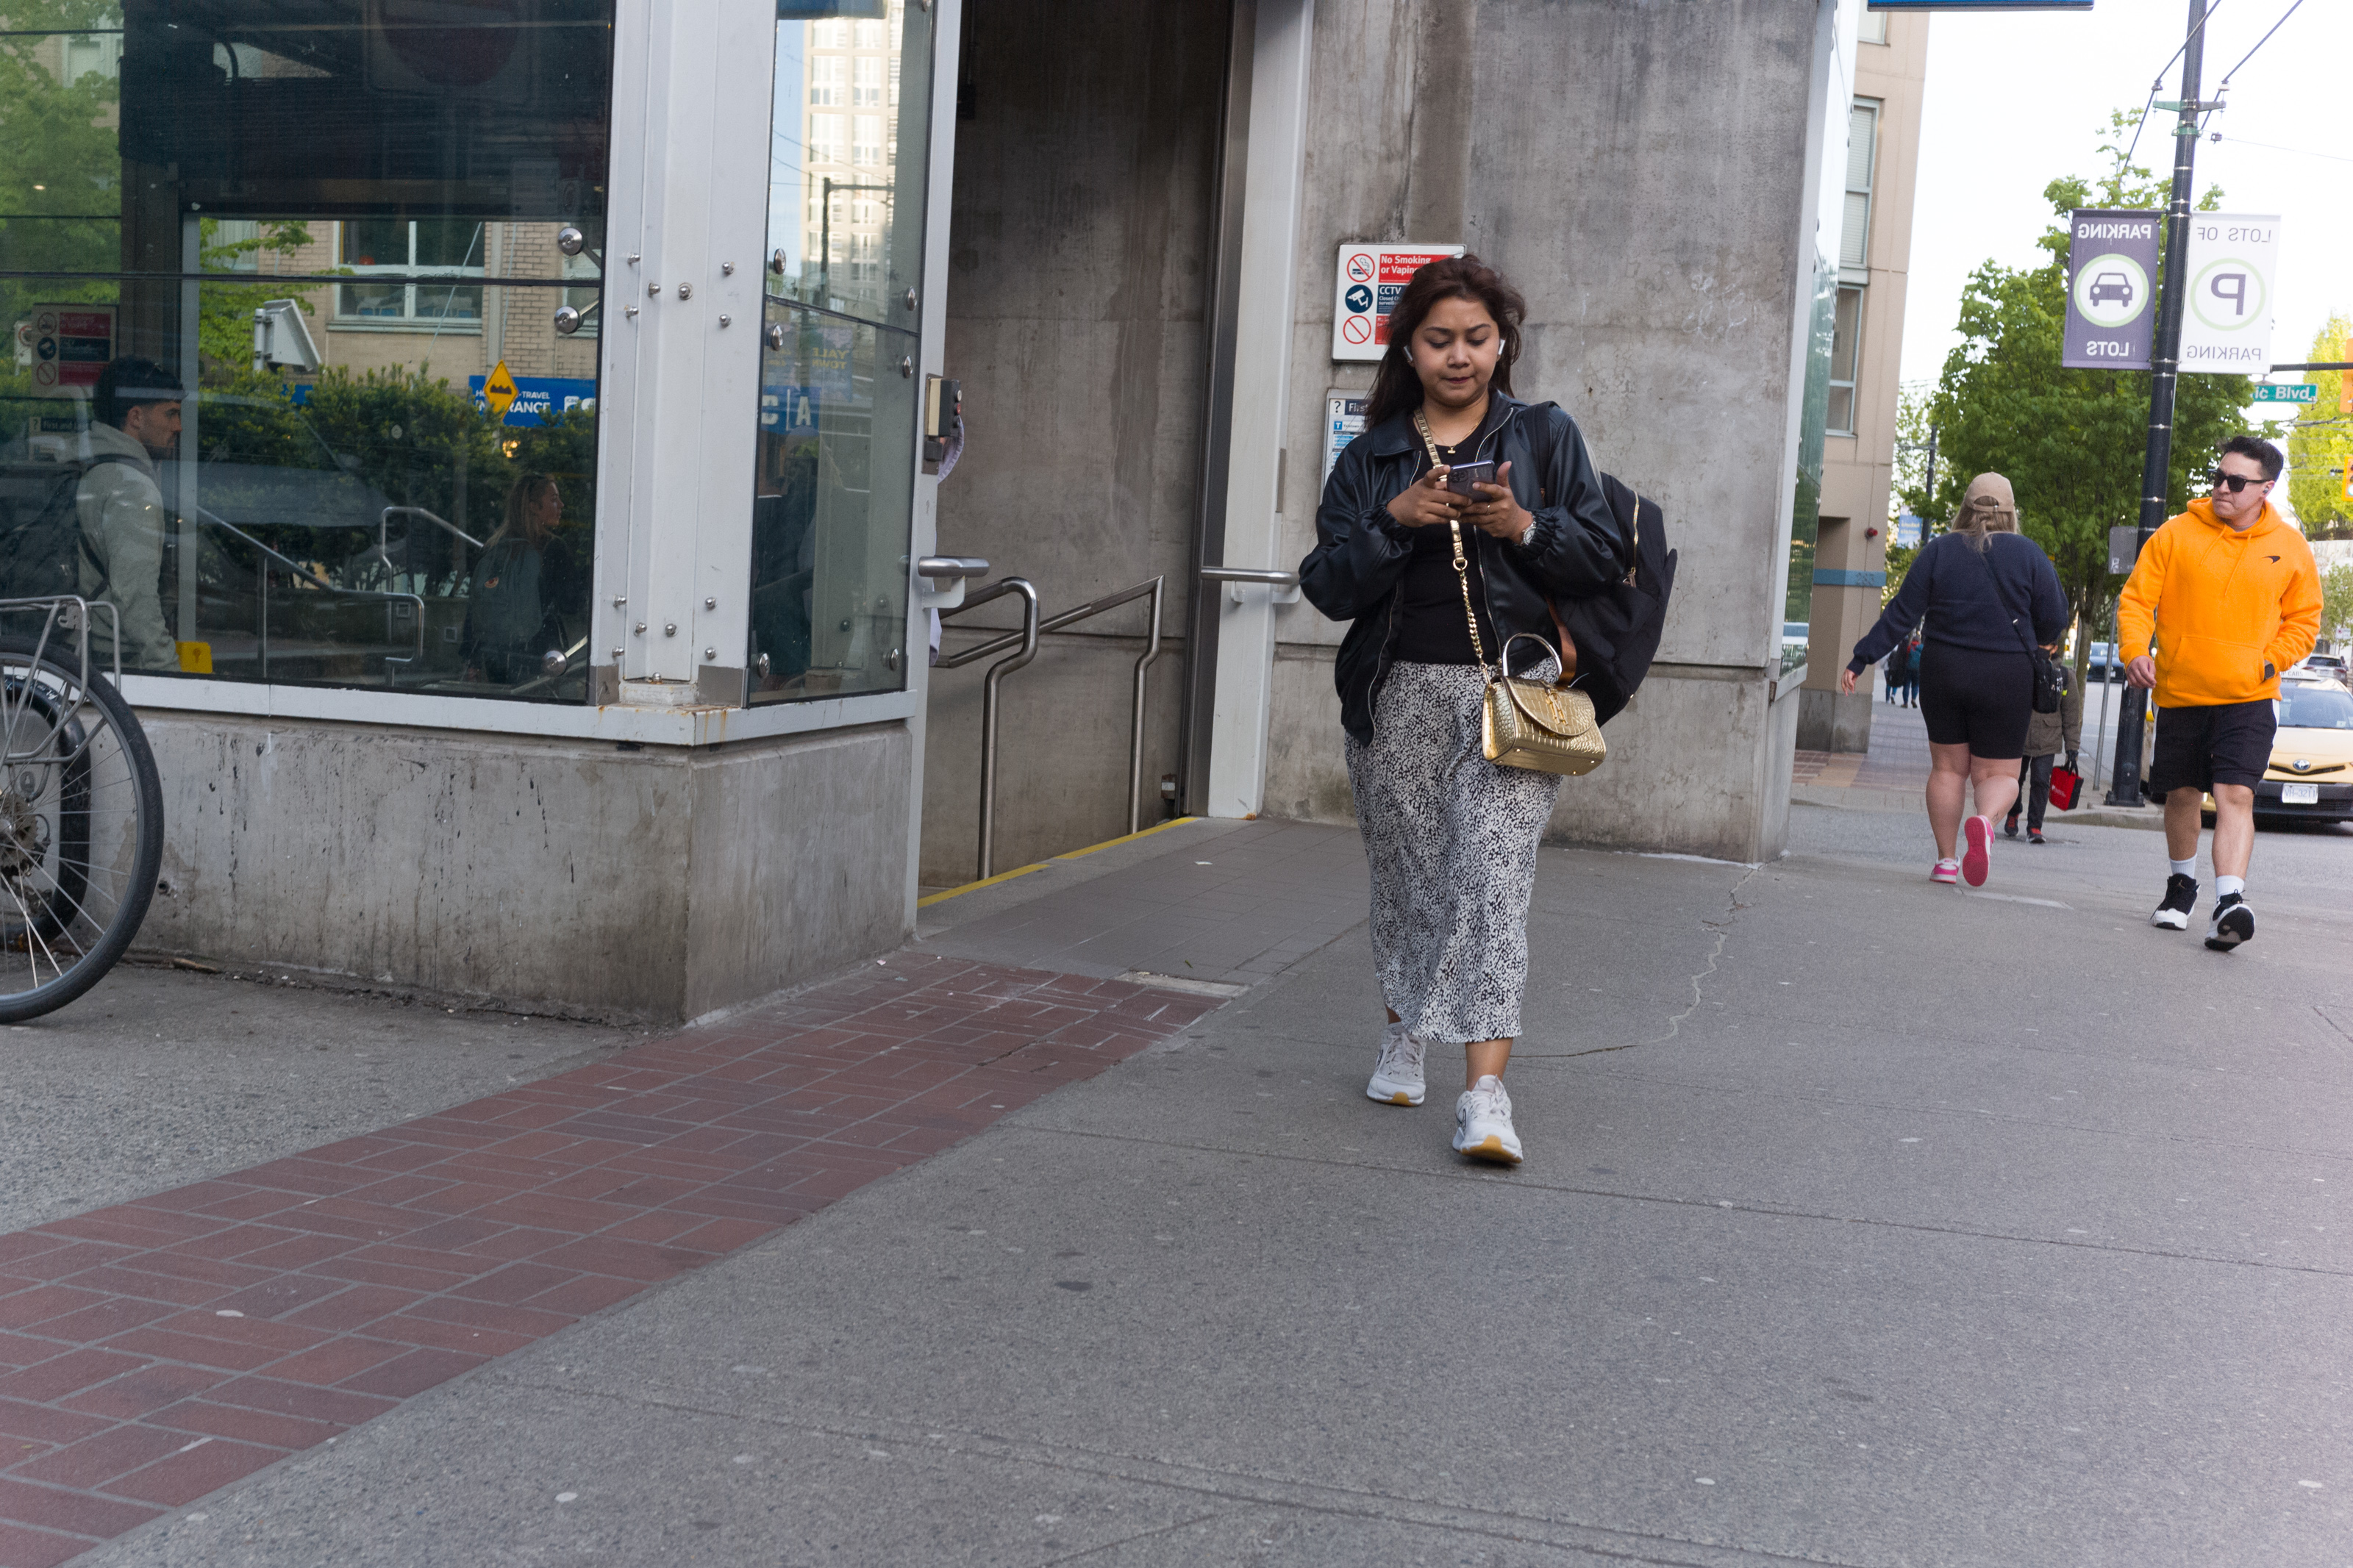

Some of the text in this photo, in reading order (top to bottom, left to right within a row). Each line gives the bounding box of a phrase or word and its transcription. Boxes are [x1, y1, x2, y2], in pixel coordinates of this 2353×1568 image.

[1381, 255, 1393, 264] No
[1391, 265, 1418, 276] Vapin
[1379, 286, 1402, 295] CCTV
[2276, 386, 2310, 399] Blvd
